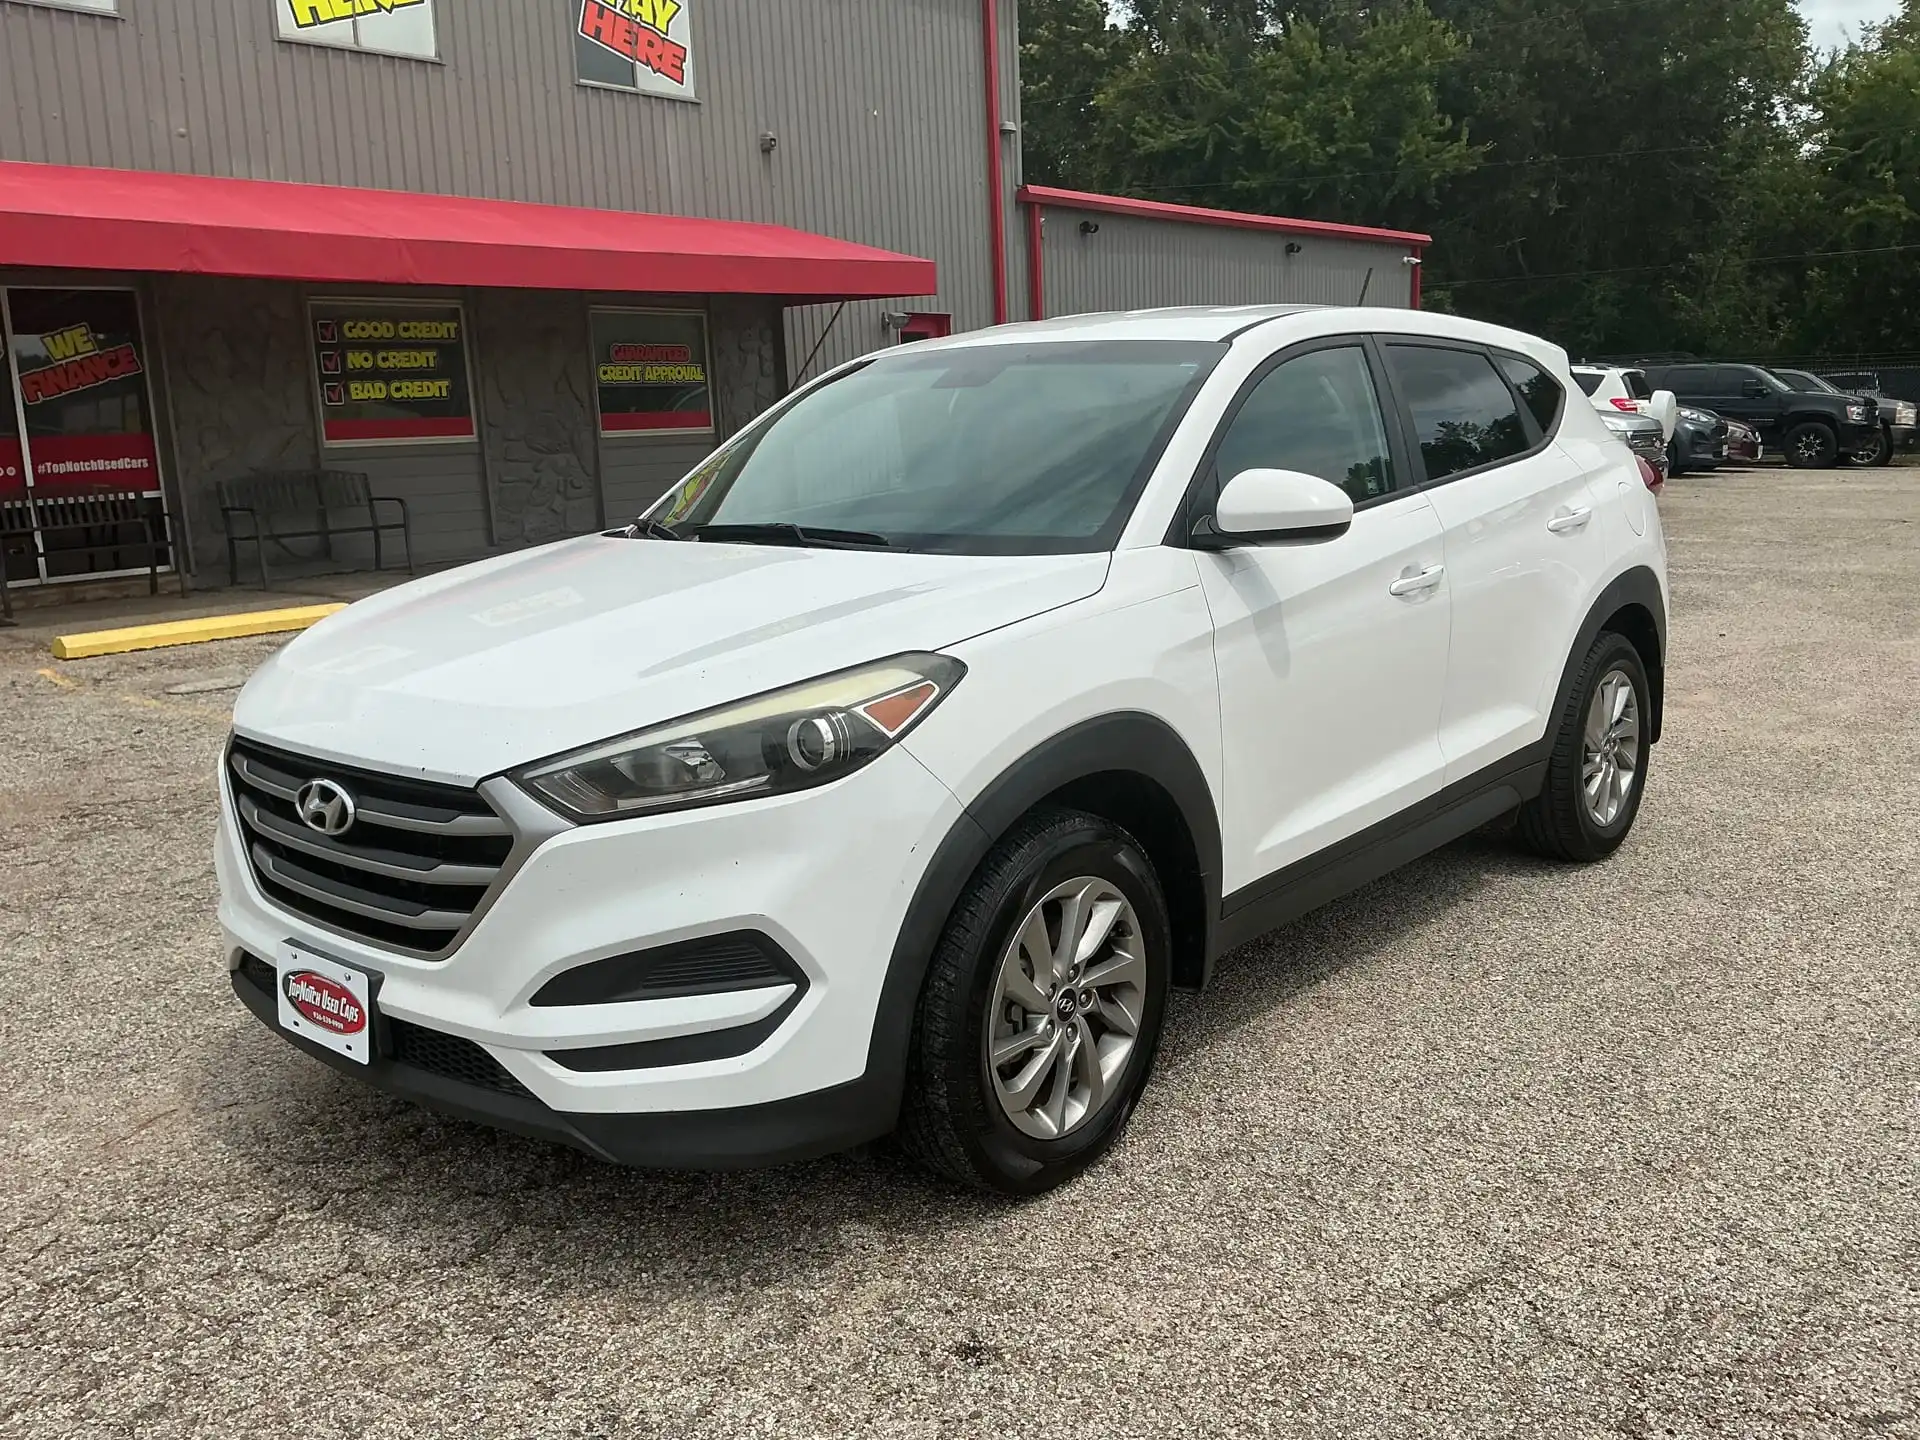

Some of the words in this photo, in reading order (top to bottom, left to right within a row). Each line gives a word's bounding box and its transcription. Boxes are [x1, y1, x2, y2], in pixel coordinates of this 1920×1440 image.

[580, 0, 687, 85] HERE
[343, 321, 395, 340] GOOD
[398, 321, 458, 340] CREDIT
[42, 324, 97, 361] WE
[347, 351, 374, 369] NO
[377, 351, 437, 369] CREDIT
[612, 344, 690, 362] GUARANTEED
[20, 344, 141, 404] FINANCE
[599, 364, 642, 382] CREDIT
[644, 364, 705, 382] APPROVAL
[349, 381, 388, 400] BAD
[390, 380, 449, 399] CREDIT
[37, 457, 149, 475] #TopNotchUsedCars
